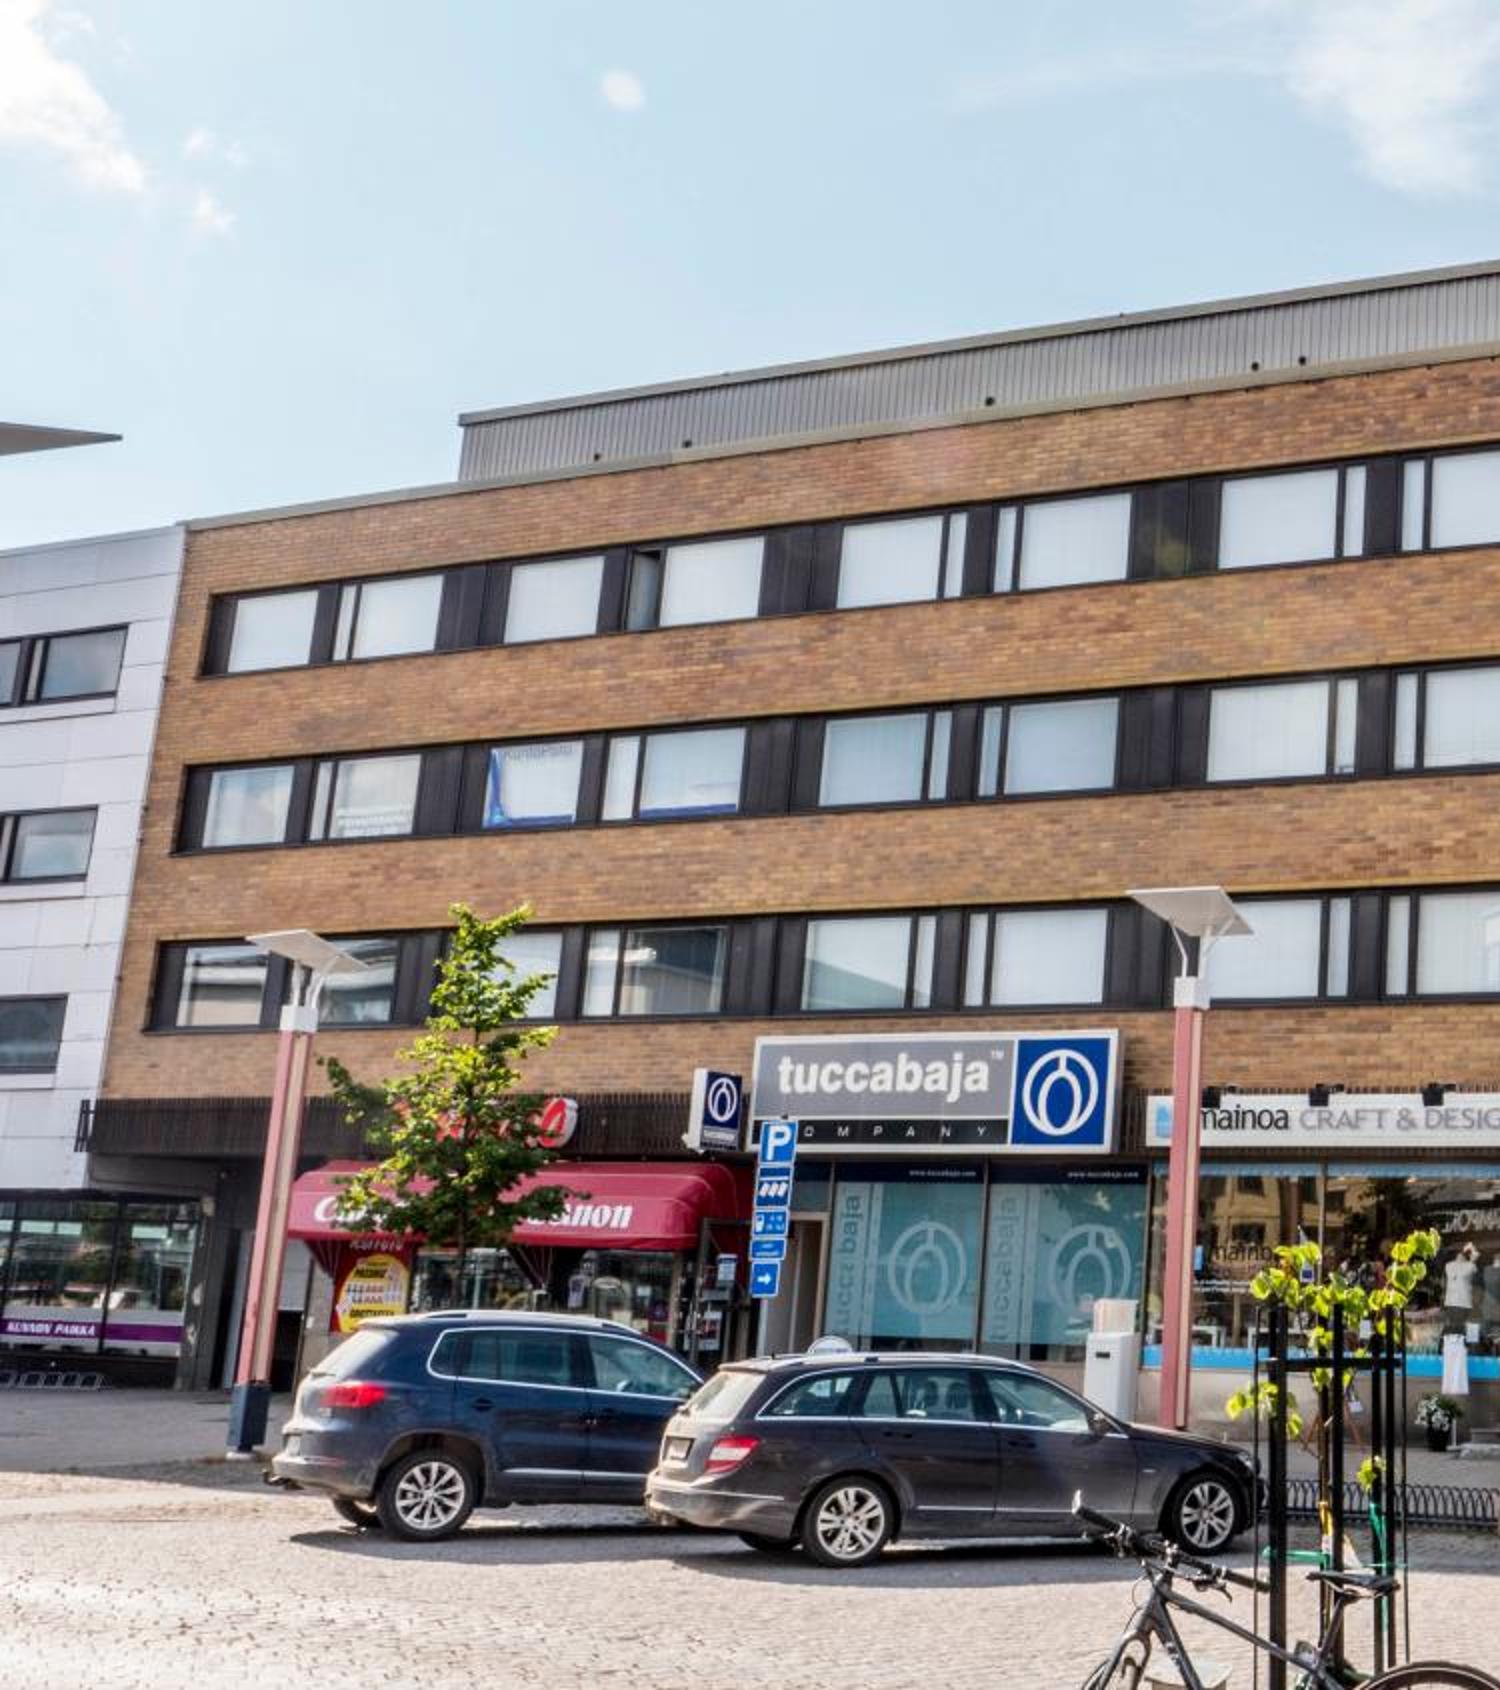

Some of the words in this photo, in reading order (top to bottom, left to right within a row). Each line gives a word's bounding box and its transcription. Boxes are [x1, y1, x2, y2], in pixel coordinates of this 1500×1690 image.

[778, 1053, 990, 1103] tuccabaja
[803, 1125, 987, 1138] OMPANY
[1299, 1108, 1388, 1130] CRAFT
[1397, 1108, 1417, 1130] &
[766, 1125, 791, 1161] P
